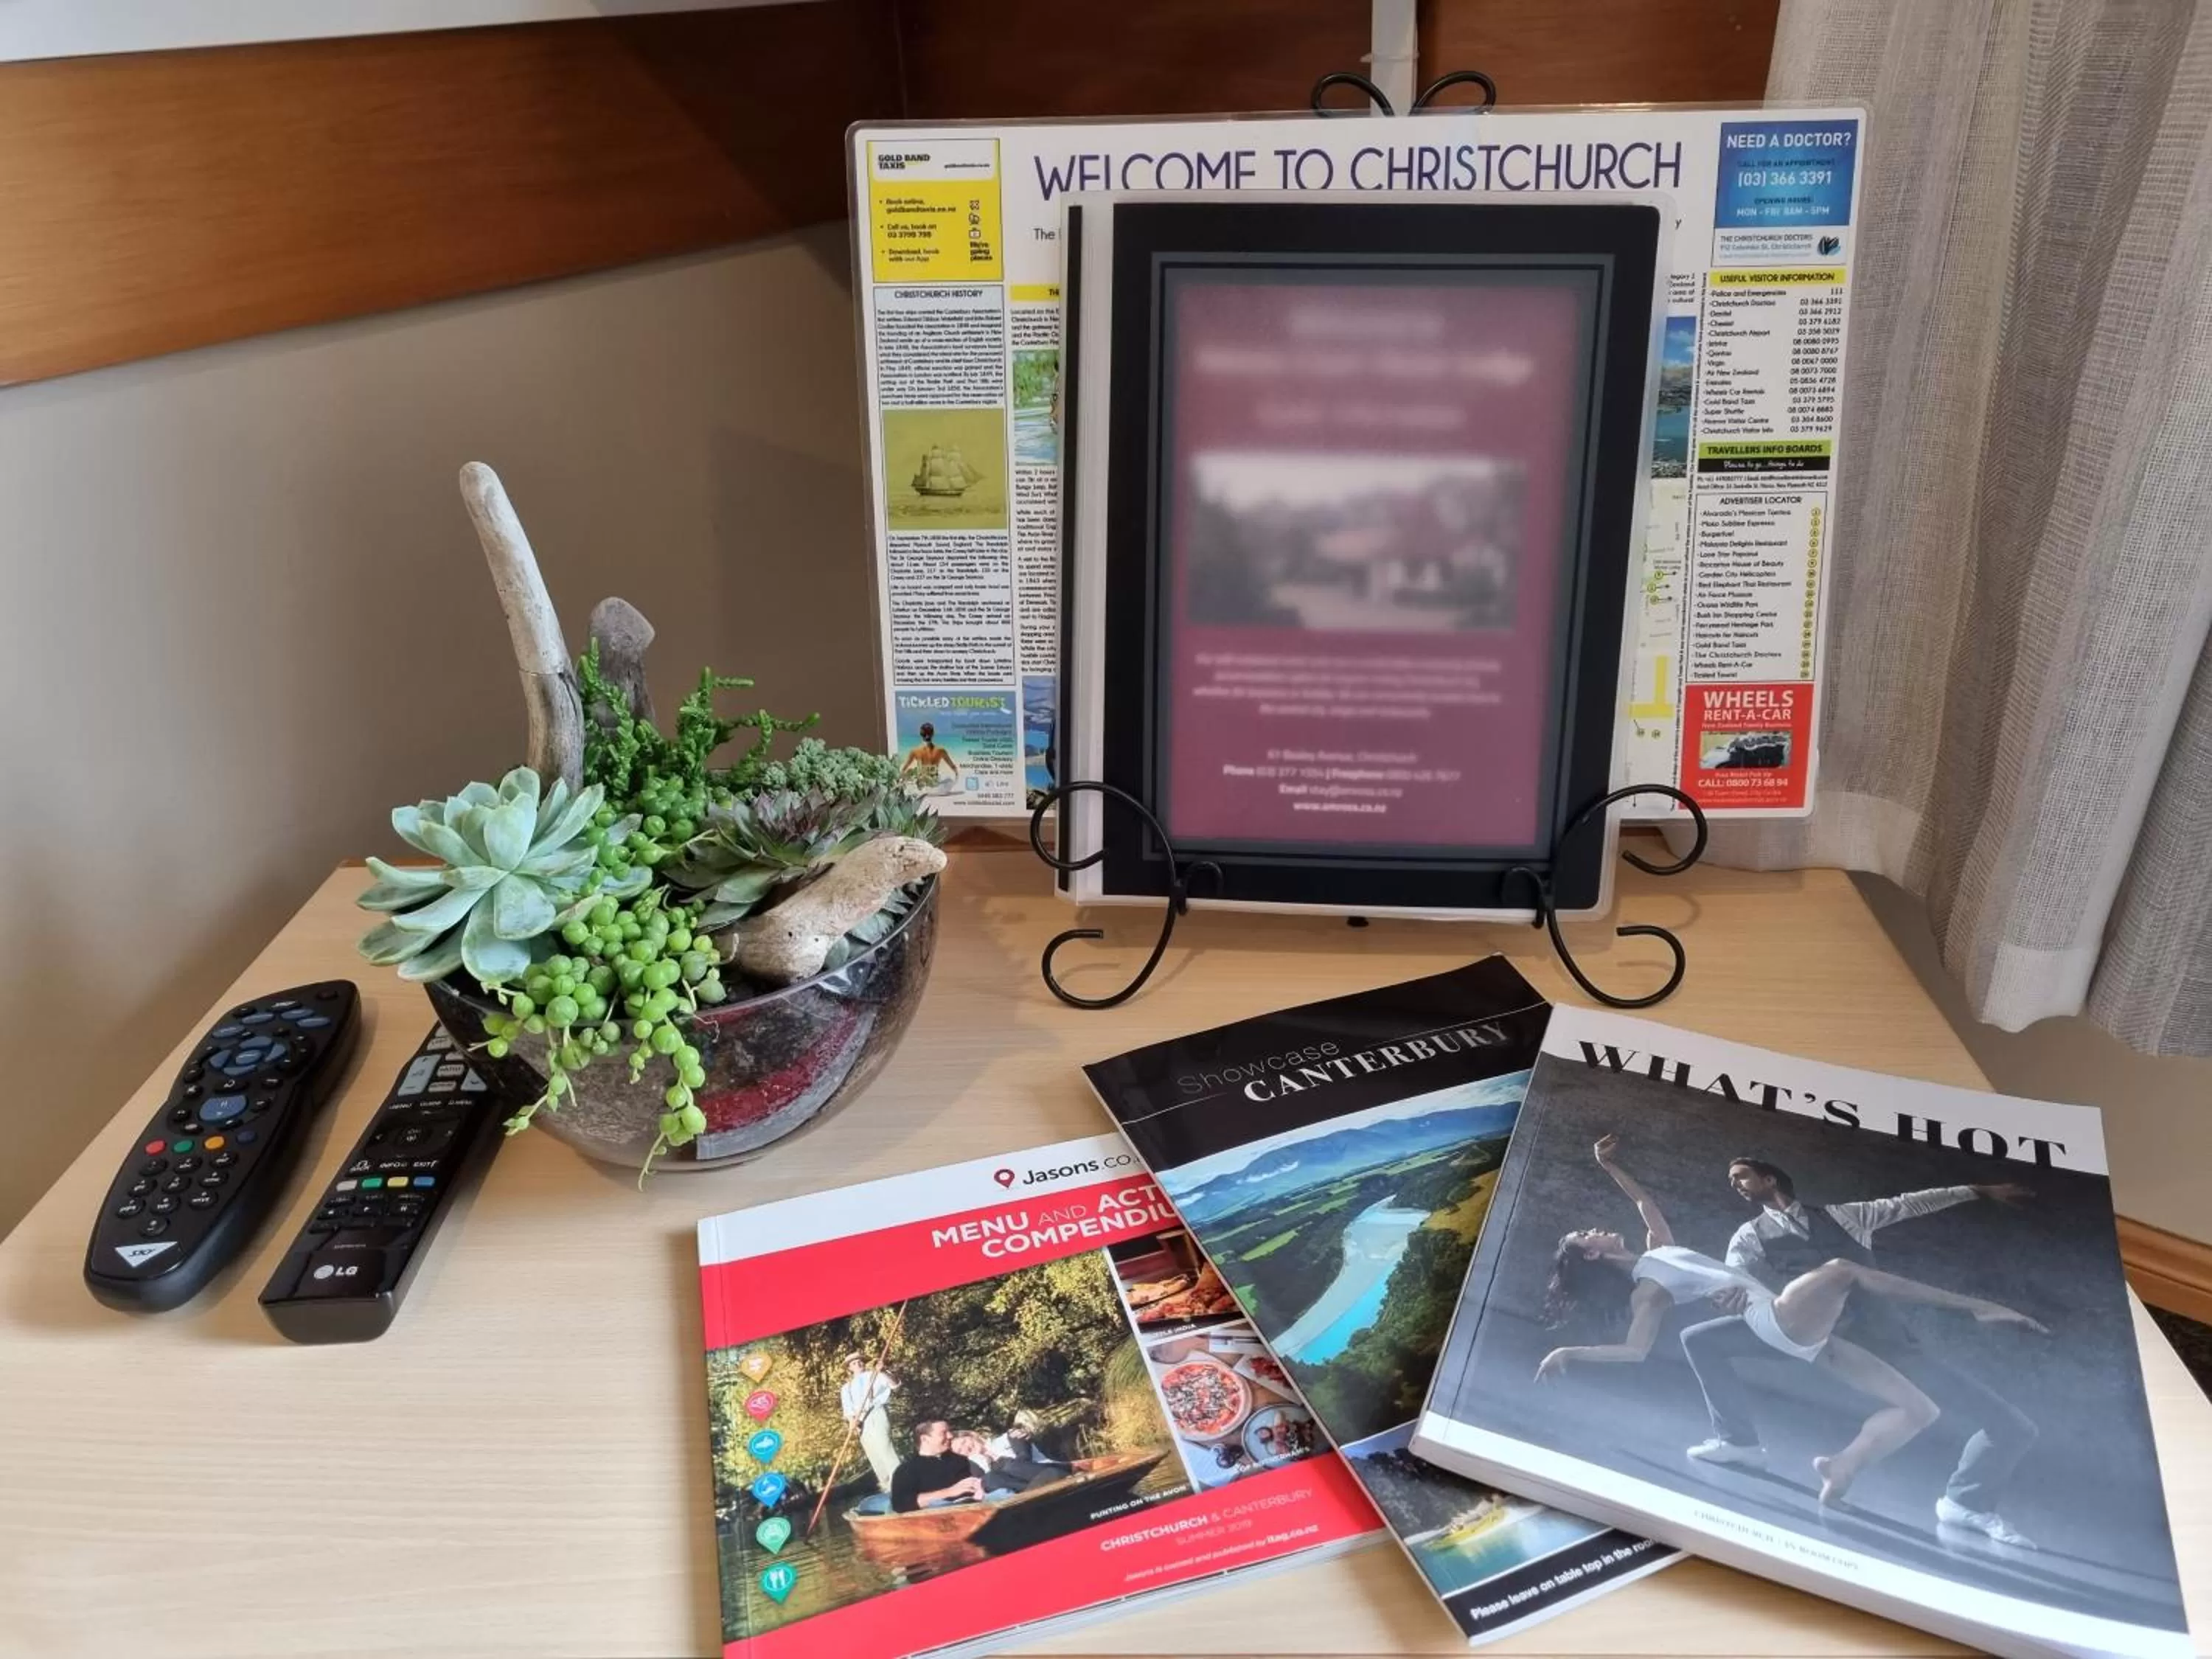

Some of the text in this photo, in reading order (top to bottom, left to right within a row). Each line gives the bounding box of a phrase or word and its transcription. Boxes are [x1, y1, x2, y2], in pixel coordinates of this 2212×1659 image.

[1727, 133, 1851, 148] NEED A DOCTOR?
[905, 153, 930, 161] BAND
[880, 161, 905, 170] TAXIS
[1274, 148, 1334, 189] TO
[1351, 142, 1682, 190] CHRISTCHURCH
[1738, 170, 1832, 187] (03) 366 3391
[1736, 208, 1756, 217] MON
[1034, 228, 1055, 241] The
[1750, 274, 1778, 282] VISITOR
[1780, 272, 1834, 282] INFORMATION
[952, 290, 983, 298] HISTORY
[1707, 445, 1822, 455] TRAVELLERS INFO BOARDS
[1719, 495, 1803, 505] ADVERTISER LOCATOR
[1703, 689, 1794, 709] WHEELS
[1703, 709, 1792, 720] RENT-A-CAR
[1726, 778, 1750, 787] 0800
[1750, 778, 1761, 787] 73
[1776, 778, 1788, 787] 94
[1177, 1039, 1340, 1095] Showcase
[1243, 1020, 1510, 1103] CANTERBURY
[1579, 1040, 2067, 1169] WHAT'S HOT
[932, 1211, 1029, 1248] MENU
[1037, 1205, 1086, 1227] AND
[335, 1266, 358, 1276] LG
[1090, 1485, 1186, 1520] PUNTING ON THE AVON
[1099, 1514, 1208, 1552] CHRISTCHURCH
[1222, 1488, 1312, 1519] CANTERBURY
[1175, 1523, 1226, 1546] SUMMER
[1194, 1552, 1211, 1563] and
[1211, 1542, 1254, 1559] published
[1255, 1538, 1267, 1548] by
[1470, 1599, 1509, 1621] Please
[1508, 1584, 1540, 1604] leave
[1540, 1579, 1554, 1593] on
[1554, 1567, 1584, 1586] table
[1582, 1558, 1603, 1576] top
[1599, 1553, 1615, 1566] in
[1613, 1547, 1633, 1560] the
